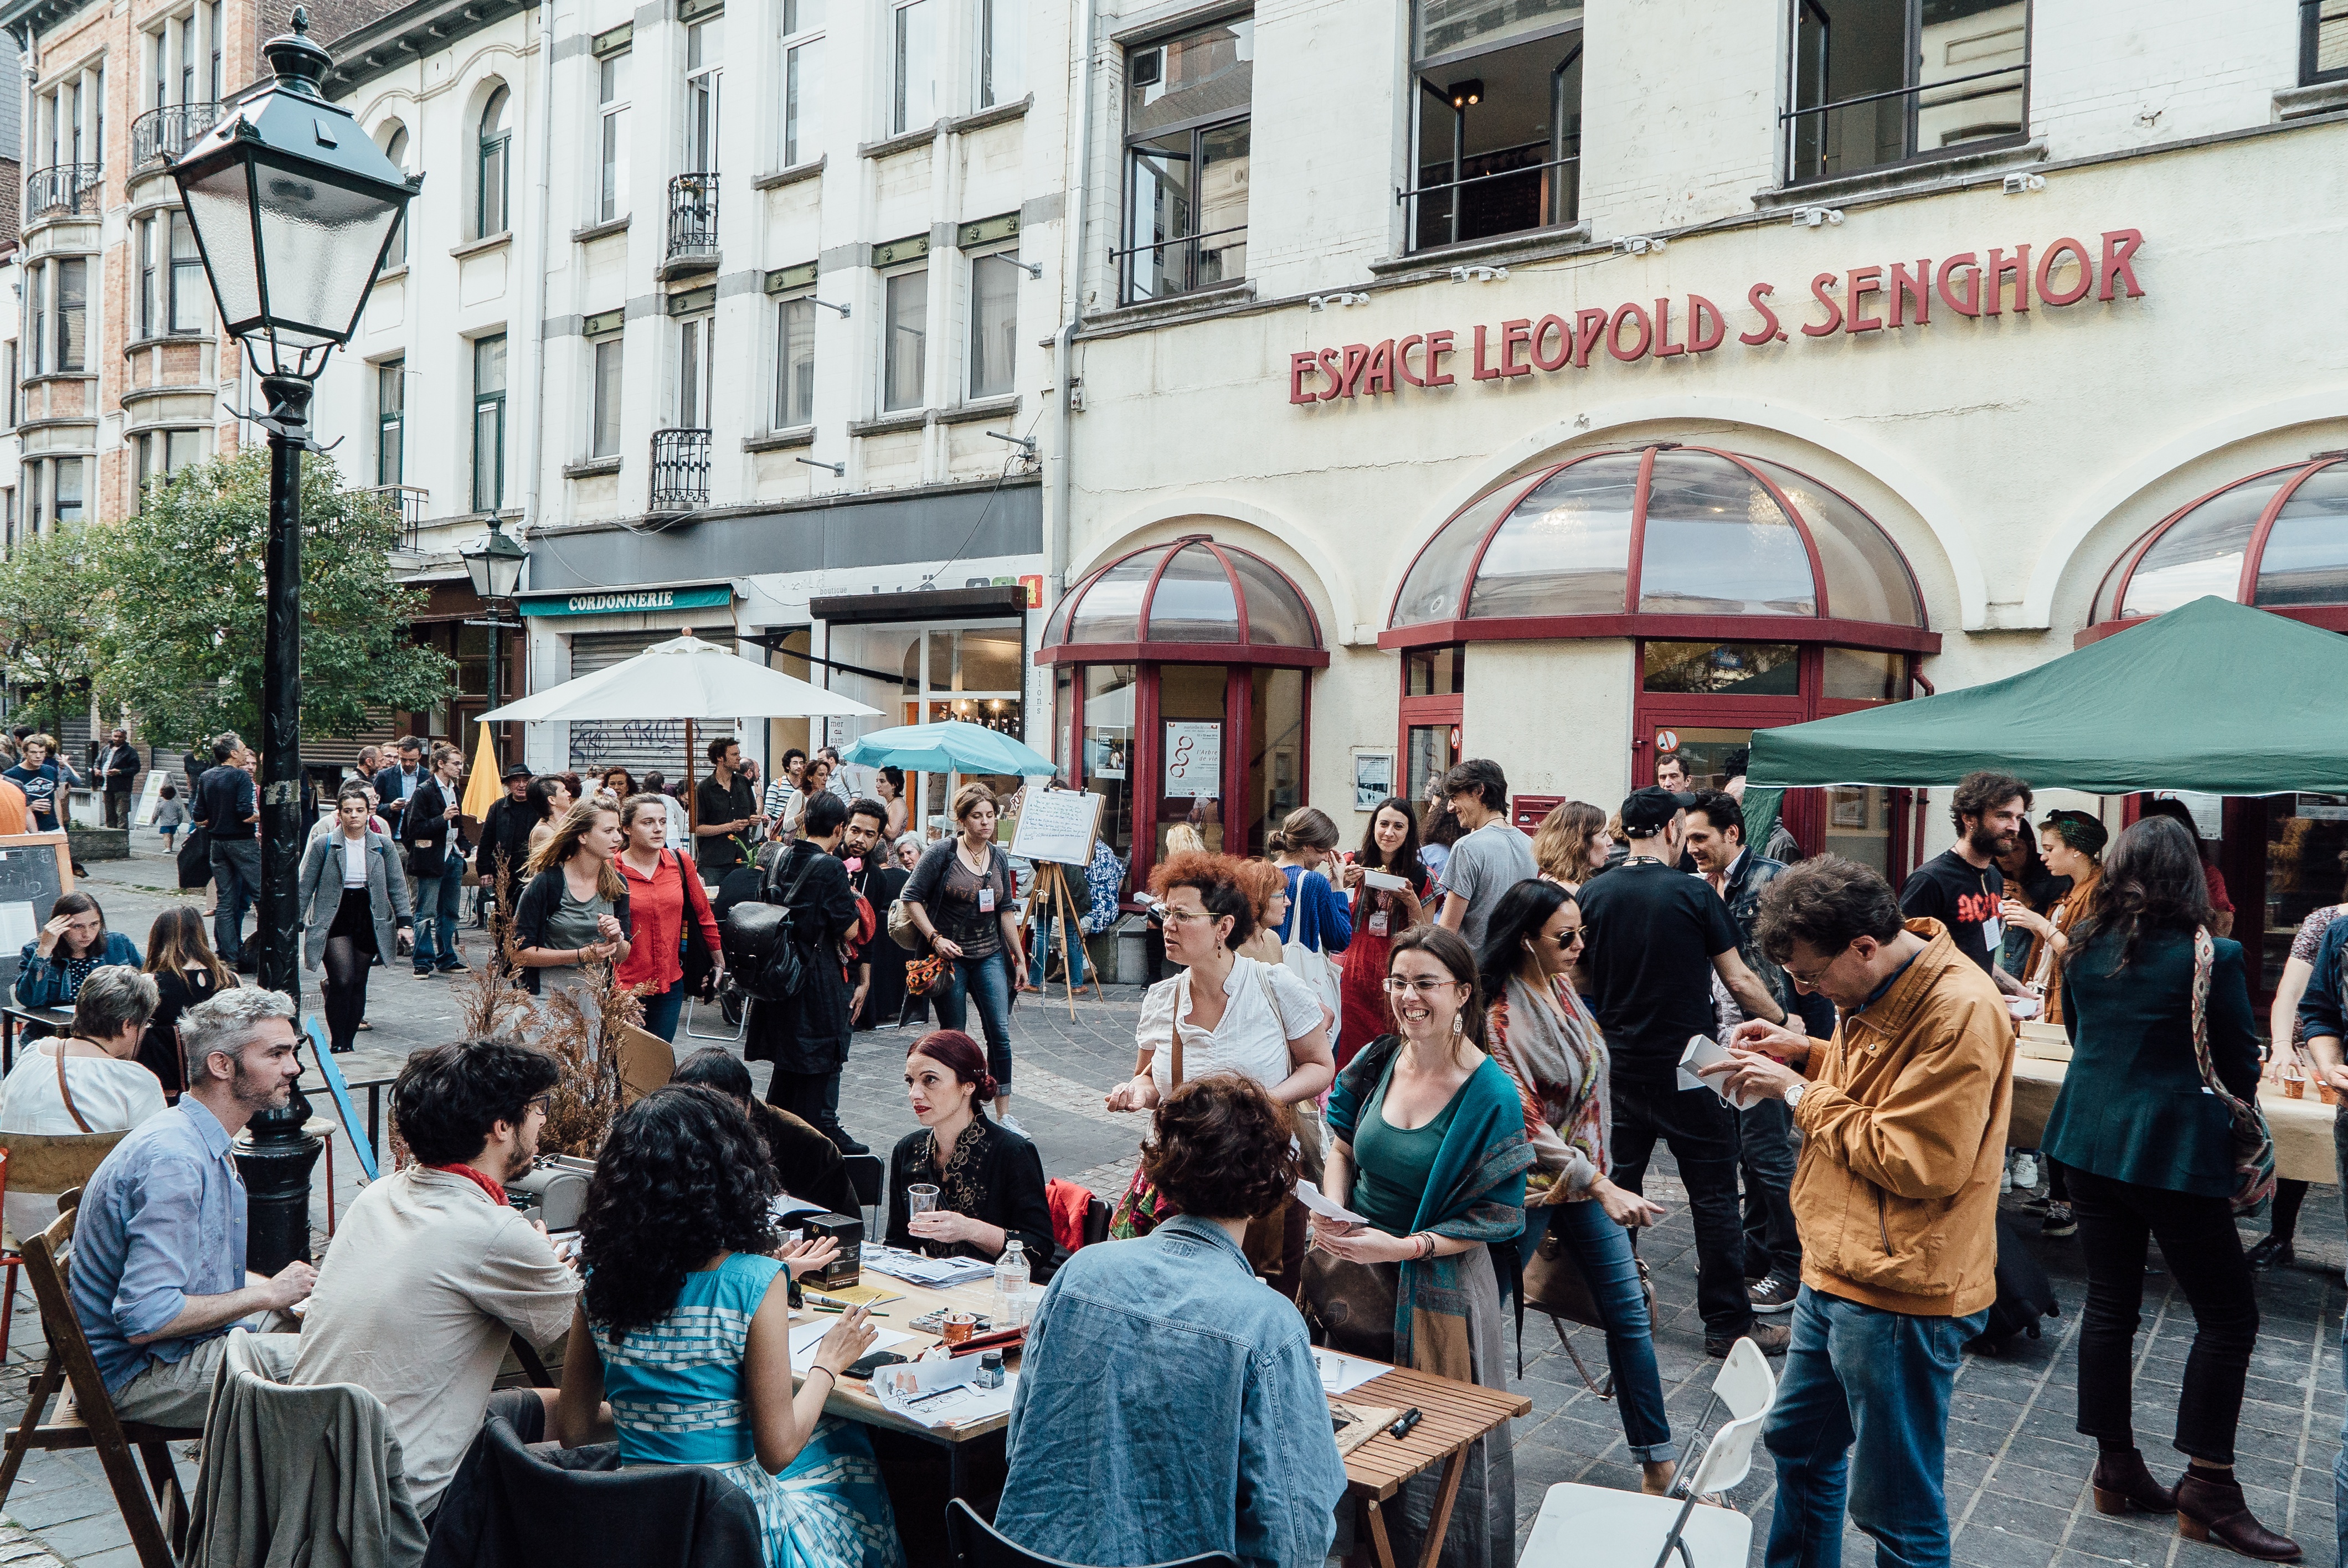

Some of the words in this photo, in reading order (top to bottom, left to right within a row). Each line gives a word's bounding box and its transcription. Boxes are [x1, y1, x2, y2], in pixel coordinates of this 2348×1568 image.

[1290, 330, 1455, 405] ESPACE
[1472, 294, 1726, 381] LEOPOLD
[1739, 283, 1789, 345] S.
[1800, 229, 2145, 336] SENGHOR
[568, 591, 673, 611] CORDONNERIE
